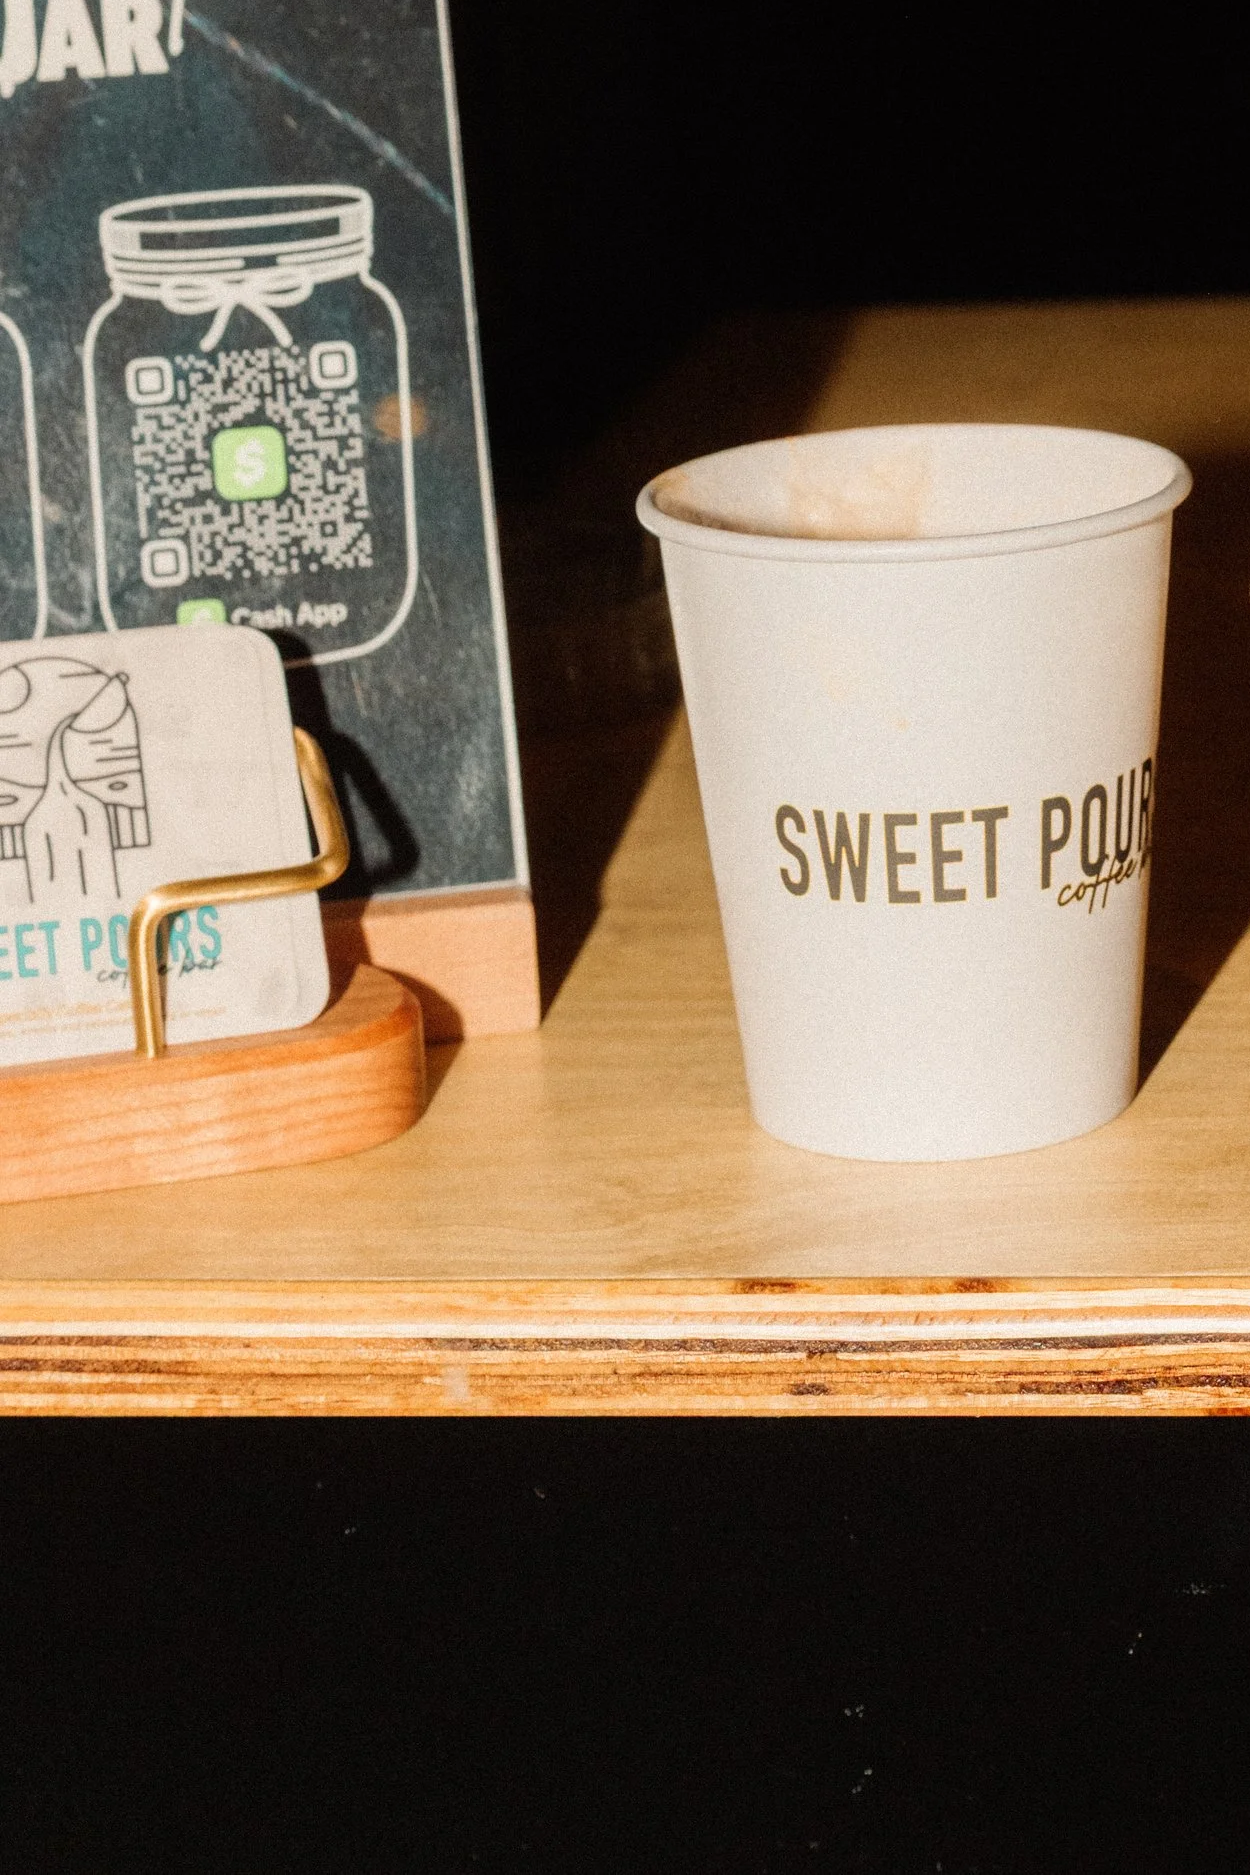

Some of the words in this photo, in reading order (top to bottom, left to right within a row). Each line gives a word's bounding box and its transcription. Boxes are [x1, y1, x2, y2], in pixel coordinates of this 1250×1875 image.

[231, 604, 293, 629] Cash
[296, 601, 348, 629] App
[774, 803, 1010, 904] SWEET
[1057, 853, 1138, 915] coffee
[79, 904, 222, 971] PORS
